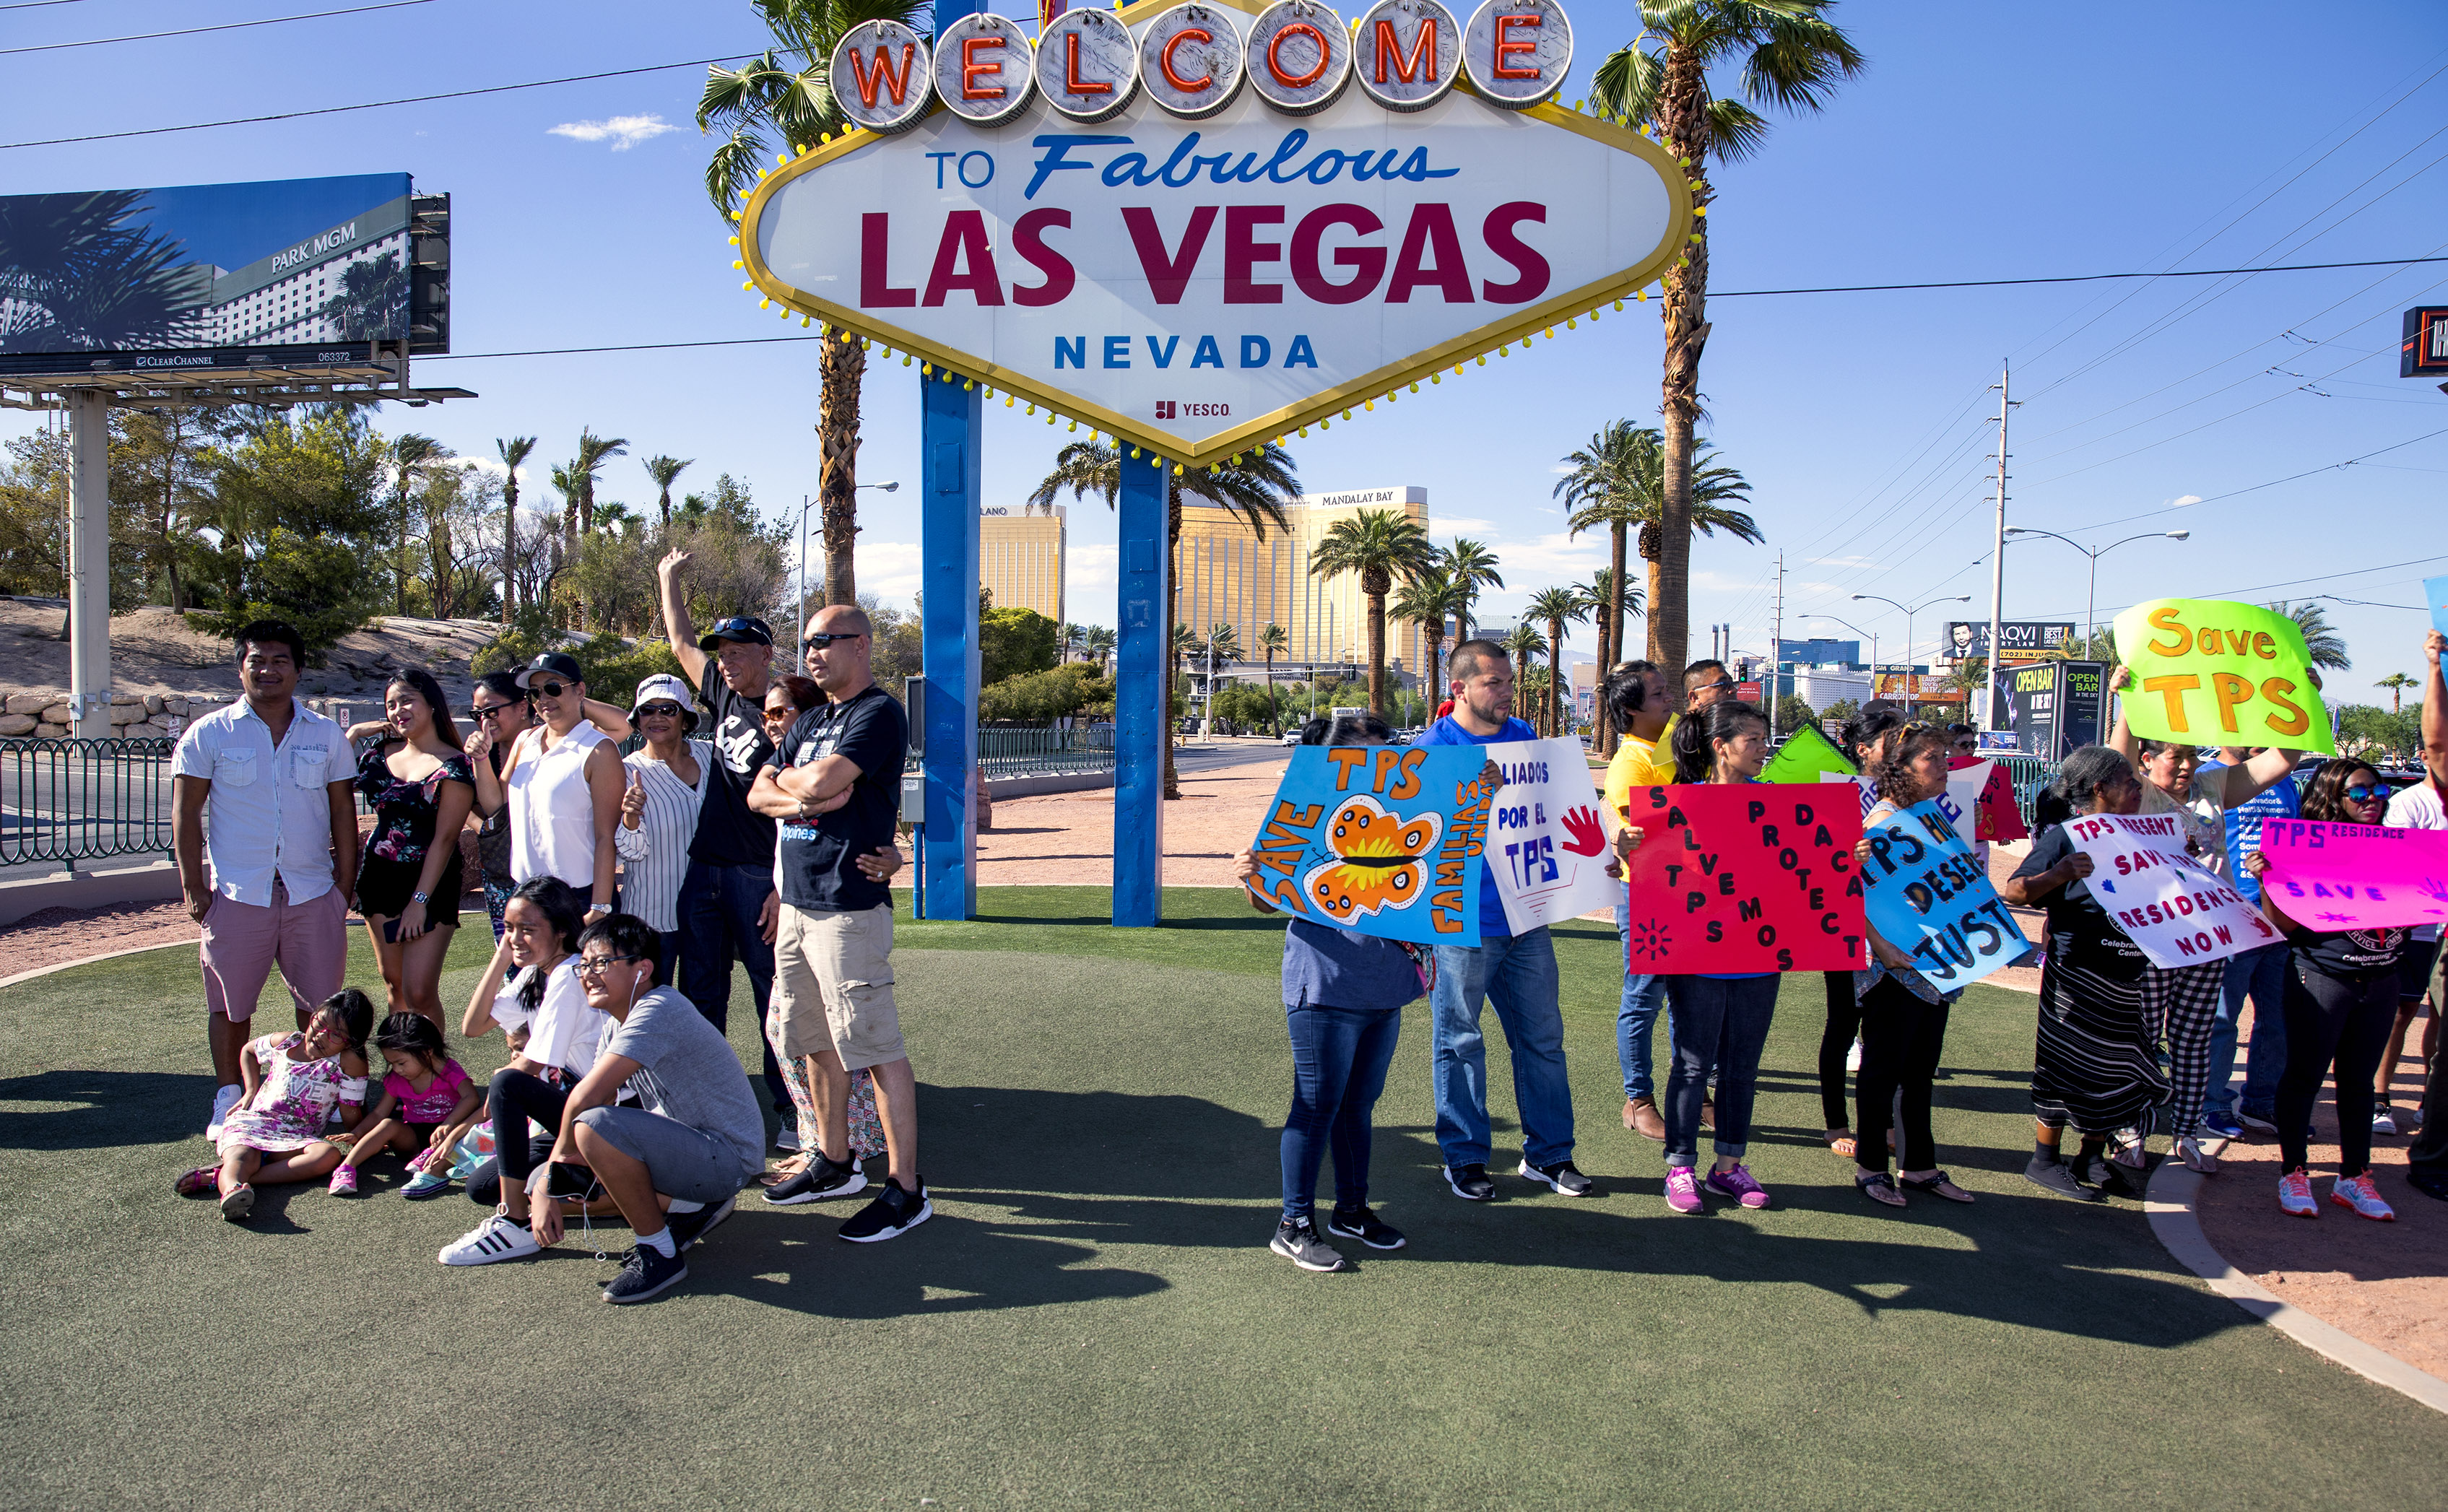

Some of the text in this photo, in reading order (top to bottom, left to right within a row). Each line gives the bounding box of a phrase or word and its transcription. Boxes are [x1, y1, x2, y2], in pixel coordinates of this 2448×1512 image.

[848, 16, 1542, 109] WELCOME
[926, 131, 1460, 200] TO Fabulous
[272, 222, 355, 274] PARK MGM
[860, 201, 1550, 308] LAS VEGAS
[318, 352, 350, 362] 063372
[1054, 334, 1319, 370] NEVADA
[1183, 404, 1229, 416] YESCO
[1322, 492, 1393, 505] MANDALAY BAY
[2044, 630, 2062, 639] BEST
[2148, 608, 2277, 659] Save
[2016, 668, 2054, 692] OPEN BAR
[2067, 673, 2098, 682] OPEN
[2075, 682, 2098, 692] BAR
[2143, 672, 2310, 736] TPS
[1327, 747, 1428, 799] TPS
[1502, 762, 1549, 785] LIADOS
[1498, 803, 1546, 830] POR EL
[2073, 817, 2175, 842] TPS PRESENT
[2269, 822, 2405, 848] TPS RESIDENCE
[1246, 800, 1325, 914] SAVE
[1431, 780, 1479, 934] FAMILIAS
[1505, 835, 1559, 890] TPS
[2114, 849, 2202, 876] SAVE TPS
[1665, 865, 1723, 942] TPS
[2118, 887, 2244, 929] RESIDENCE
[2286, 882, 2388, 901] SAVE
[1912, 897, 2018, 979] JUST
[2175, 924, 2233, 957] NOW
[2350, 929, 2377, 949] RVICE
